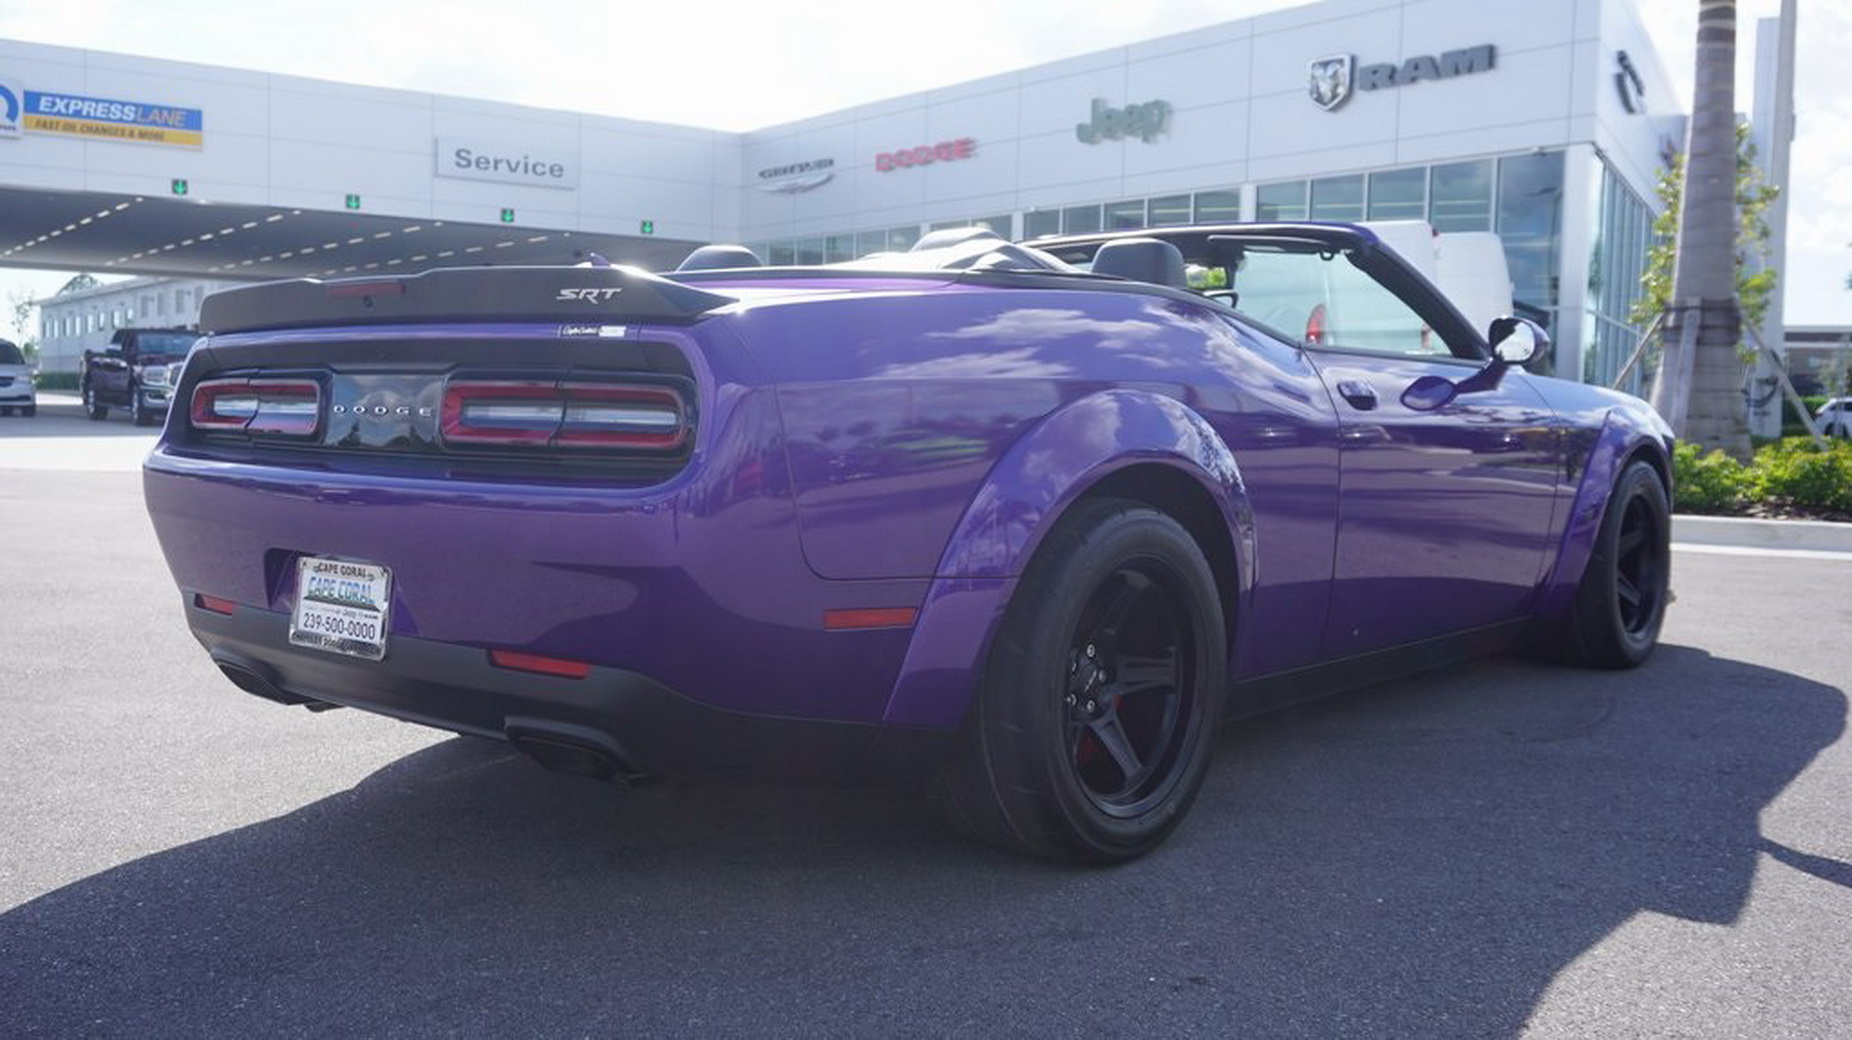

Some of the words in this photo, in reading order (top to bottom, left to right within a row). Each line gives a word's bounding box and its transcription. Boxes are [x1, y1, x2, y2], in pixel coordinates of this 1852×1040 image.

[1358, 44, 1496, 91] RAM
[1076, 98, 1171, 145] Jeep
[454, 148, 564, 178] Service
[875, 138, 974, 173] DODGE
[556, 287, 622, 304] SRT
[333, 404, 432, 417] DODGE
[318, 562, 338, 575] CAPE
[340, 565, 367, 578] CORAL
[308, 576, 337, 597] CAPE
[338, 580, 376, 605] CORAL
[303, 612, 376, 640] 239-500-0000
